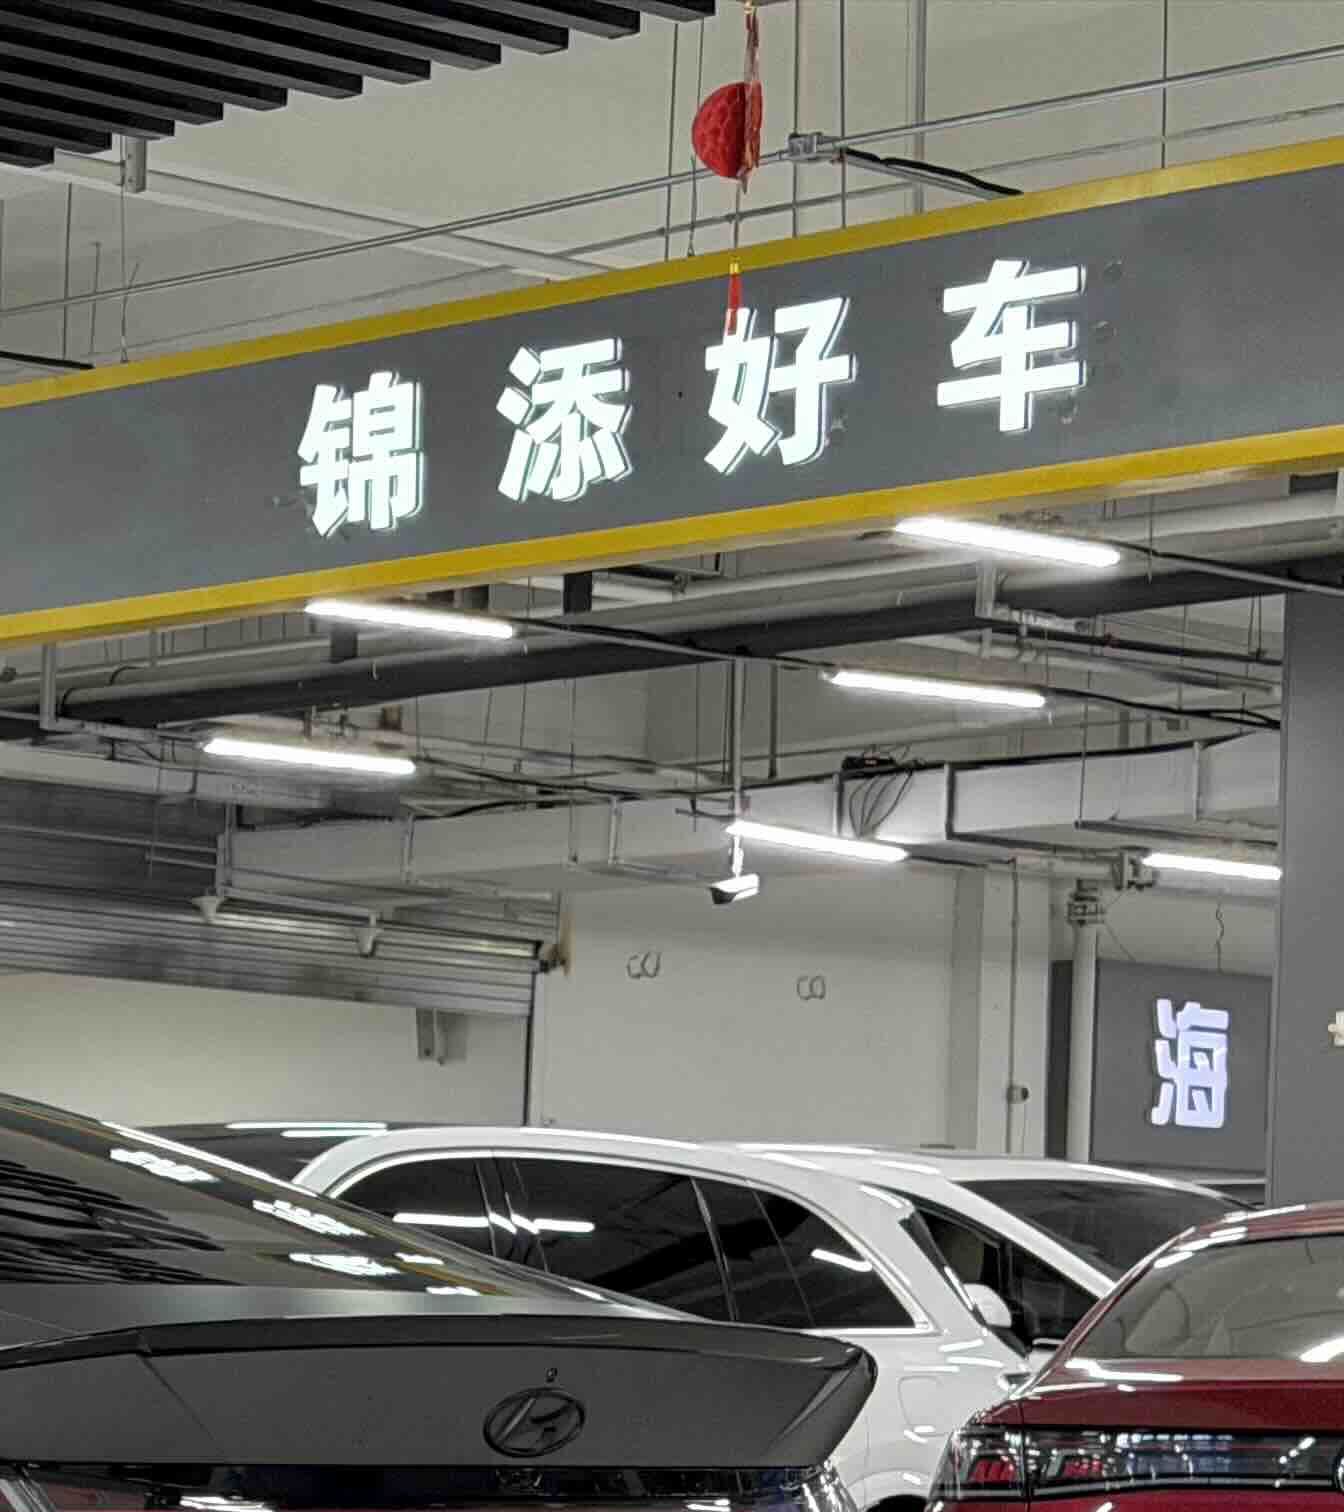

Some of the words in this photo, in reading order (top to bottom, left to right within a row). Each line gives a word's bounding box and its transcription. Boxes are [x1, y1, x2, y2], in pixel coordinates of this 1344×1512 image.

[297, 258, 1088, 538] 锦添好车
[1150, 998, 1230, 1129] 海
